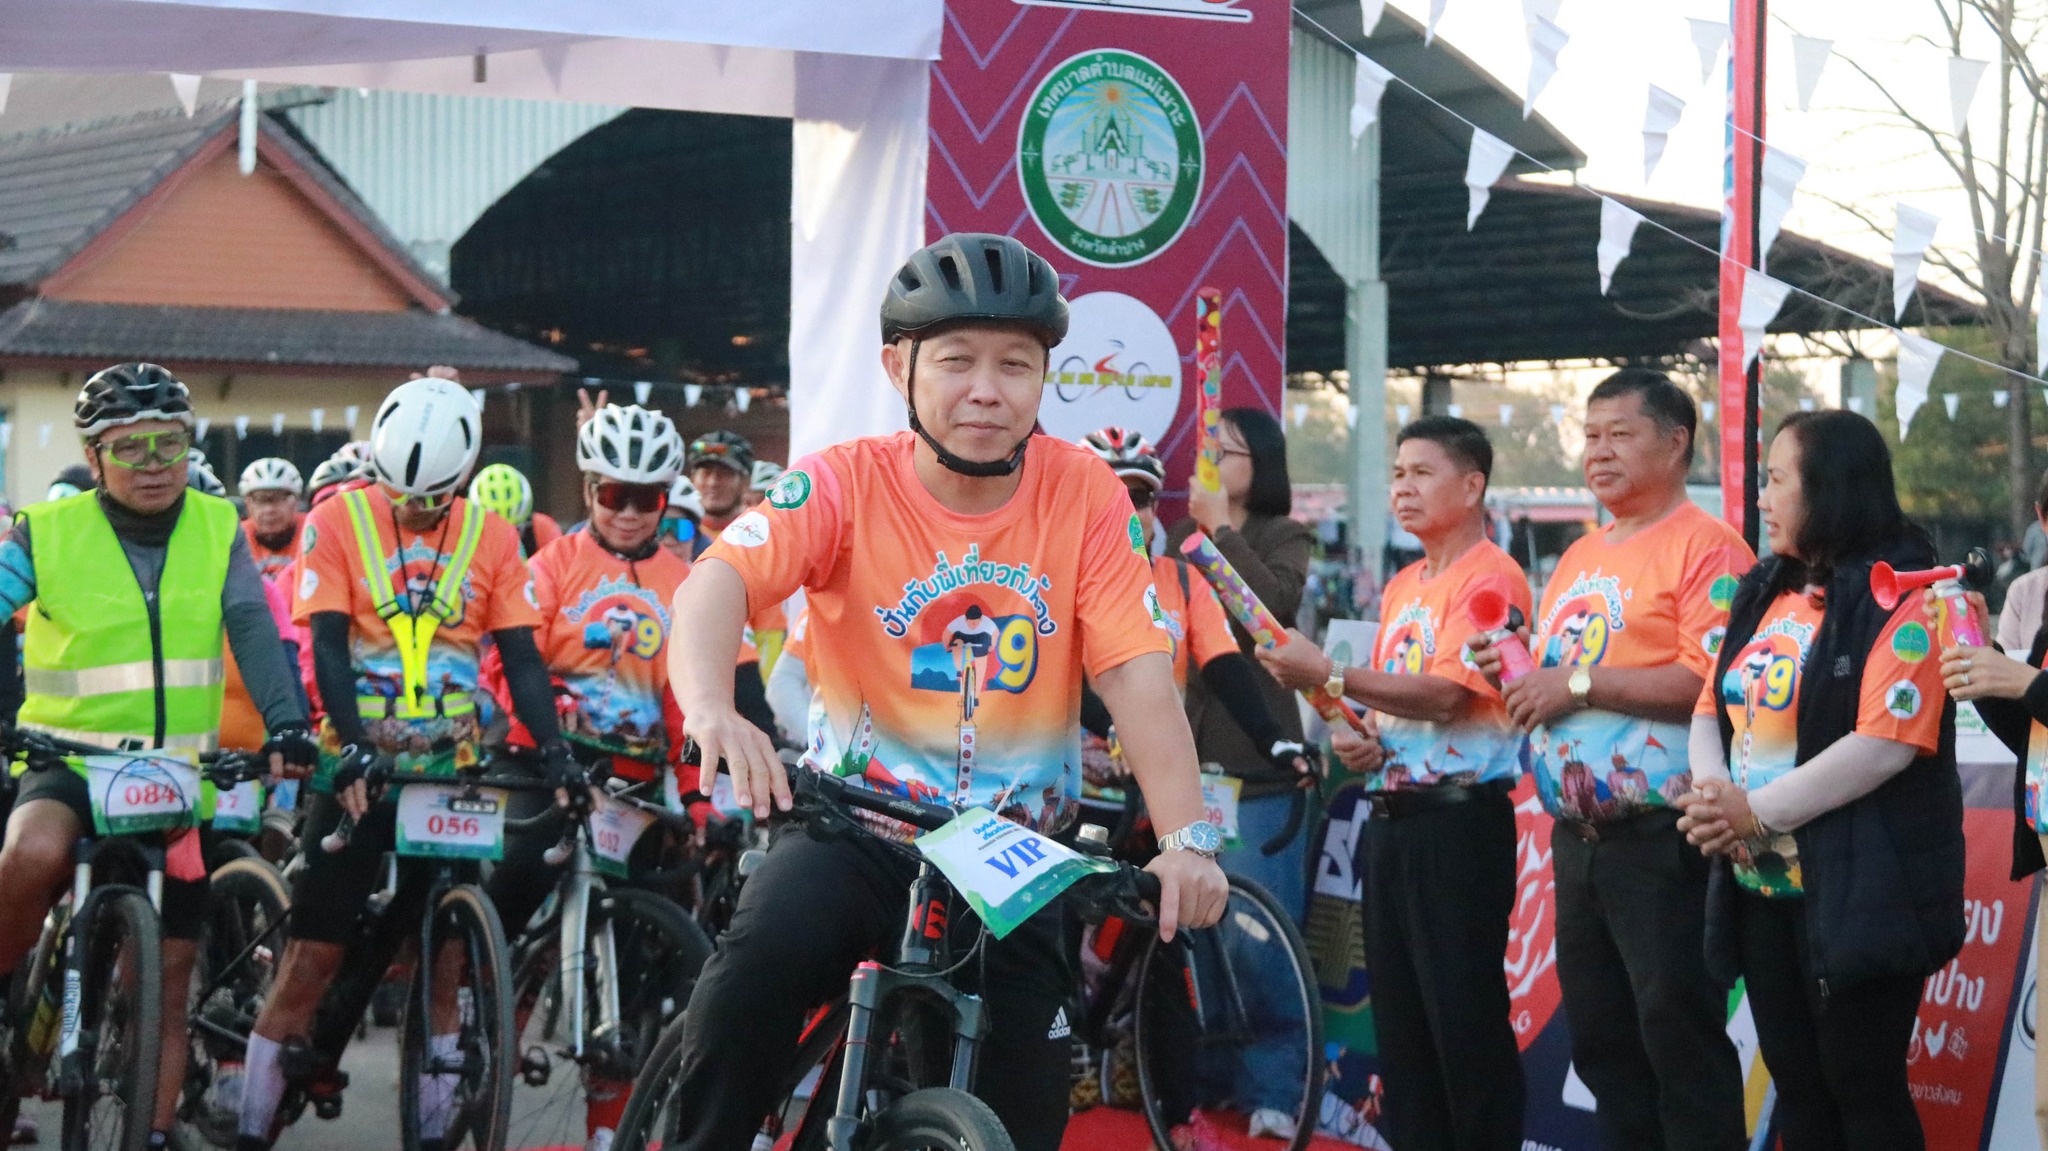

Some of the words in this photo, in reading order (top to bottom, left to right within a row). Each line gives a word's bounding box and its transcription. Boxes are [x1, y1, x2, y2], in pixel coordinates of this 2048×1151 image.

[1036, 54, 1187, 128] เทศบาลตำบลแม่เมาะ
[1069, 230, 1146, 256] จังหวัดลำปาง
[996, 613, 1039, 694] 9
[1764, 654, 1796, 711] 9
[124, 784, 176, 806] 084
[428, 815, 479, 837] 056
[985, 837, 1048, 879] VIP
[1048, 1025, 1071, 1040] adidas
